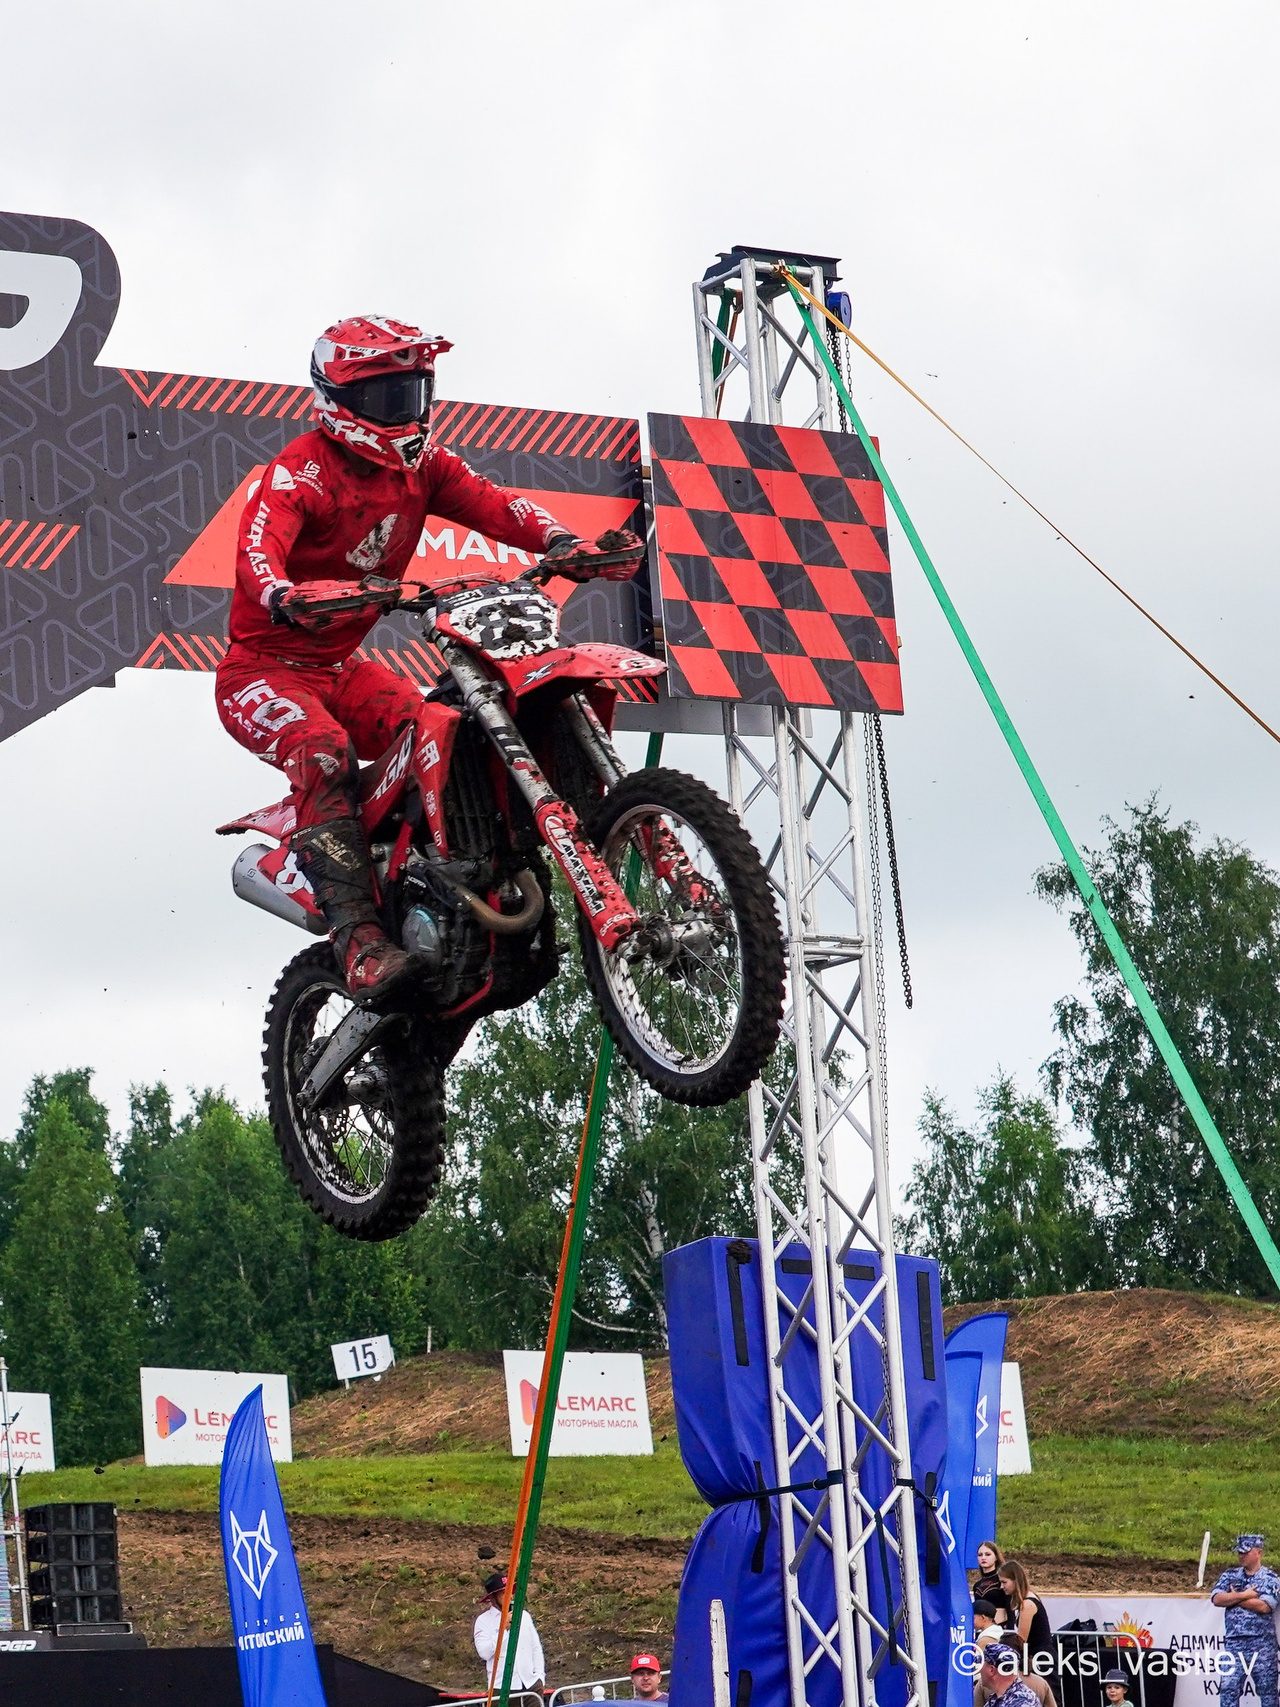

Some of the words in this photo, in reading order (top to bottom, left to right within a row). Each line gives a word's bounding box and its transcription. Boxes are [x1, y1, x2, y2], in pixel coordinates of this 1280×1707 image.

[349, 1343, 377, 1372] 15
[194, 1408, 278, 1429] LEMC
[558, 1419, 606, 1428] МОТОРНЫЕ
[607, 1419, 638, 1429] МАСЛА
[195, 1433, 226, 1442] МОТОР
[1169, 1634, 1227, 1653] АДМИН
